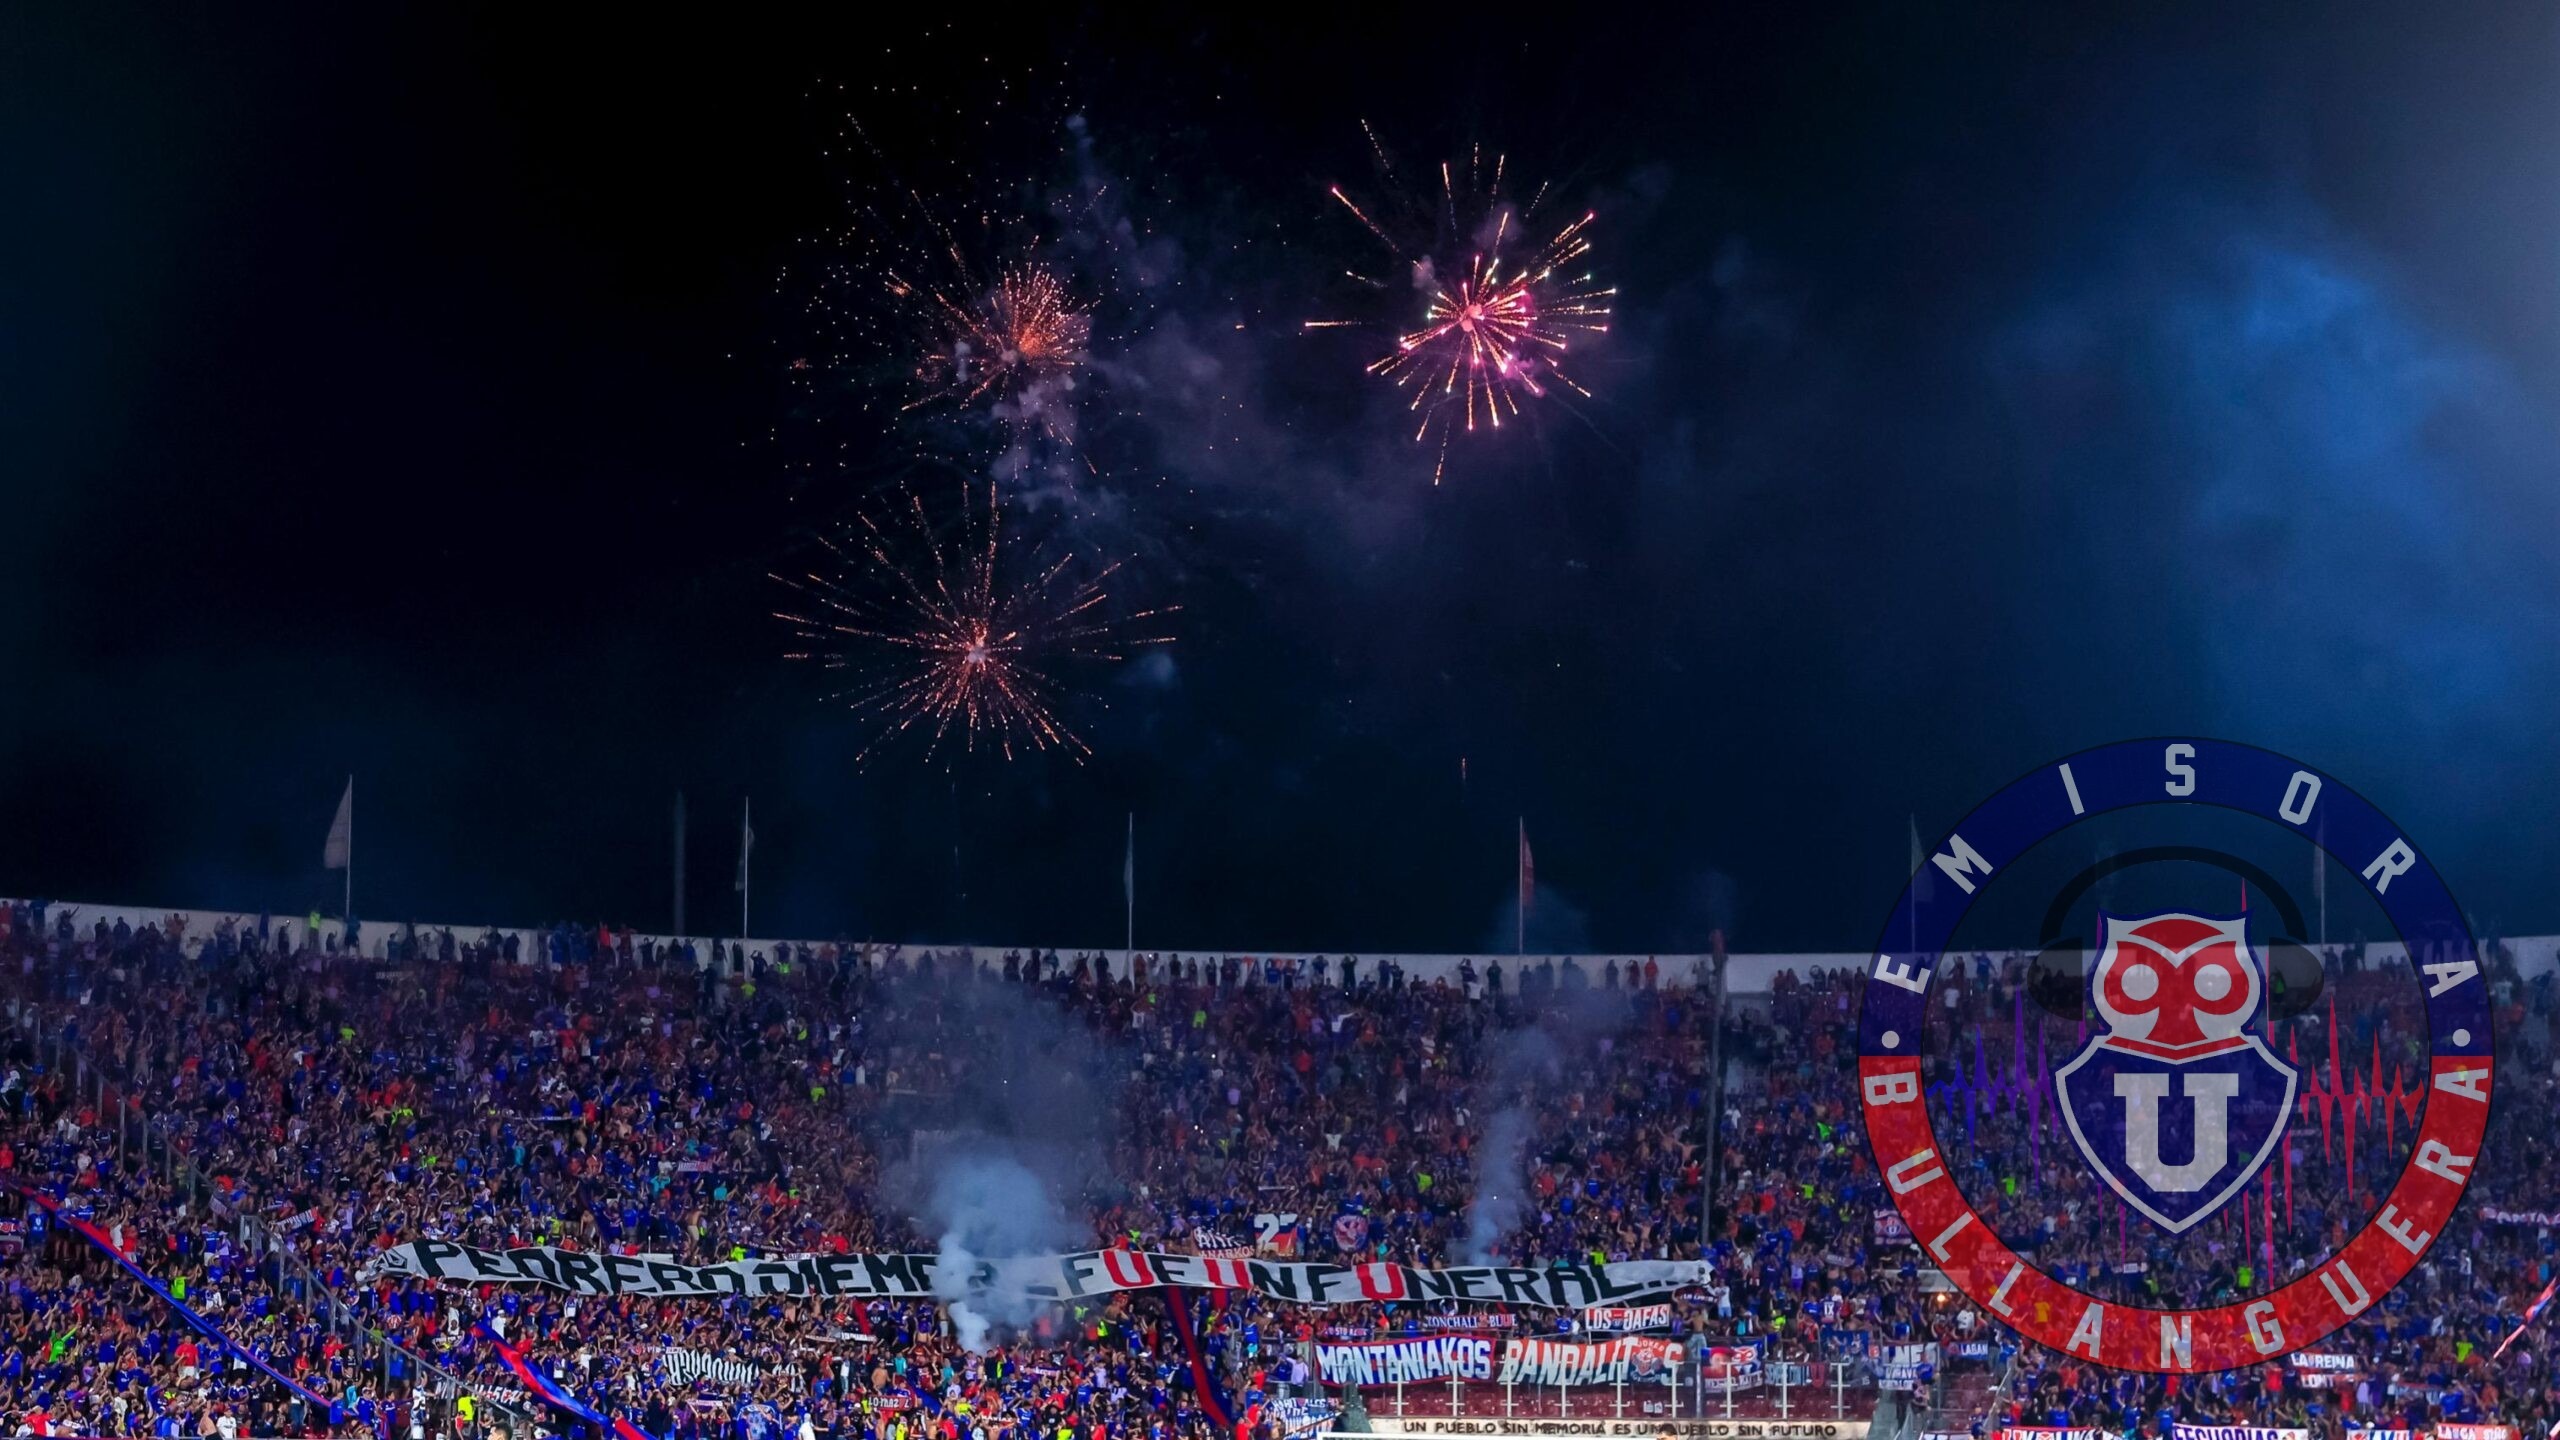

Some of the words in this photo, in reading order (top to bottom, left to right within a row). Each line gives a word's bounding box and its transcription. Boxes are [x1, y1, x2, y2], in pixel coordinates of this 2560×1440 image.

[1585, 1307, 1612, 1330] LOS
[1315, 1336, 1491, 1386] MONTANIAKOS
[1403, 1421, 1427, 1433] UN
[1434, 1421, 1496, 1434] PUEBLO
[1502, 1422, 1528, 1434] SIN
[1535, 1422, 1606, 1435] MEMORIA
[1615, 1423, 1631, 1435] ES
[1675, 1423, 1729, 1436] UEBLO
[1738, 1424, 1763, 1436] SIN
[1772, 1424, 1837, 1436] FUTURO
